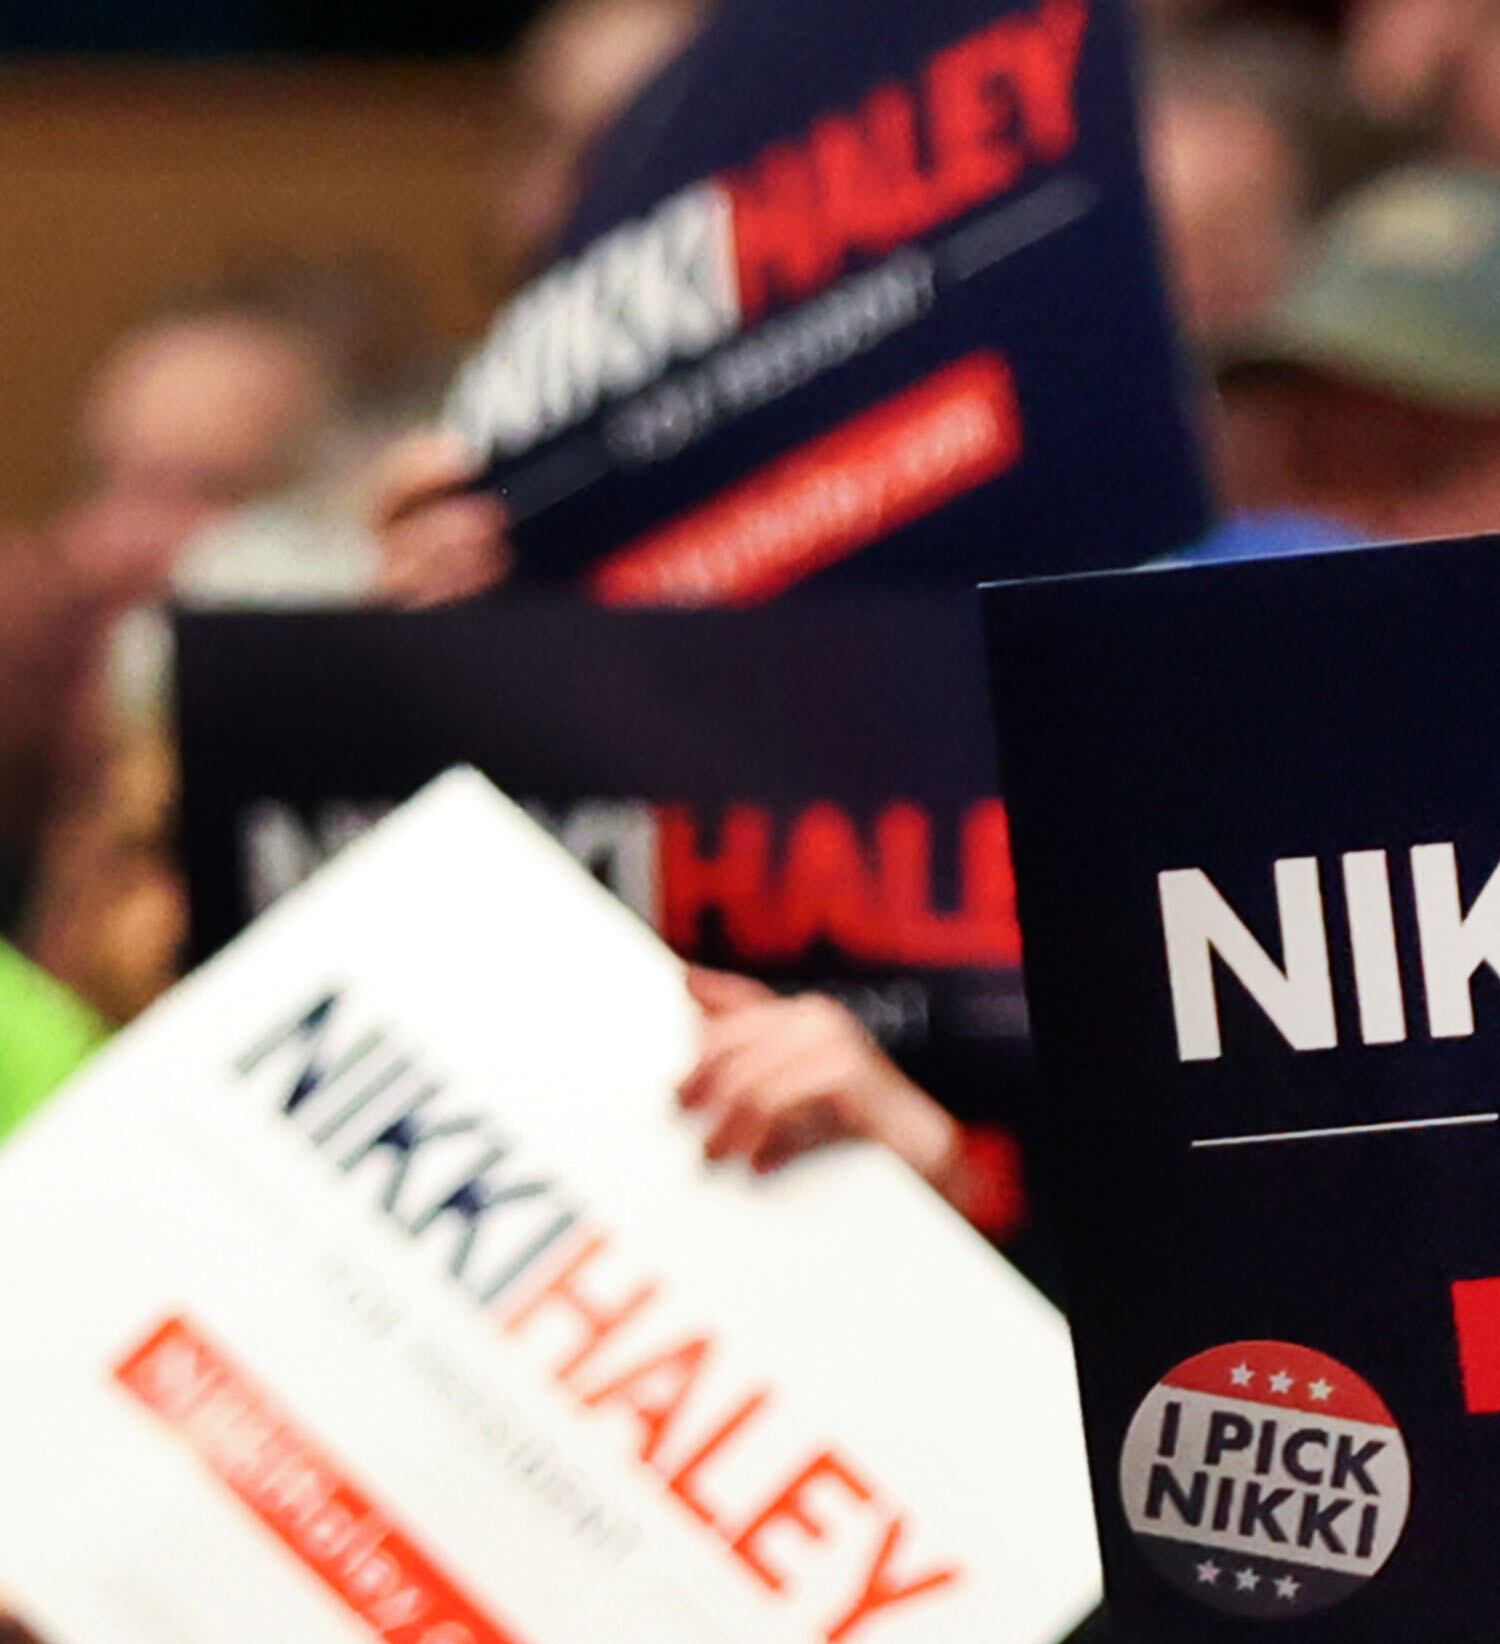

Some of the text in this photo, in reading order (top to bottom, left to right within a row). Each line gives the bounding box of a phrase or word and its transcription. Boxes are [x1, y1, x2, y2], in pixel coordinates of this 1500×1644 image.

[1156, 1401, 1388, 1497] I PICK
[1143, 1463, 1379, 1559] NIKKI
